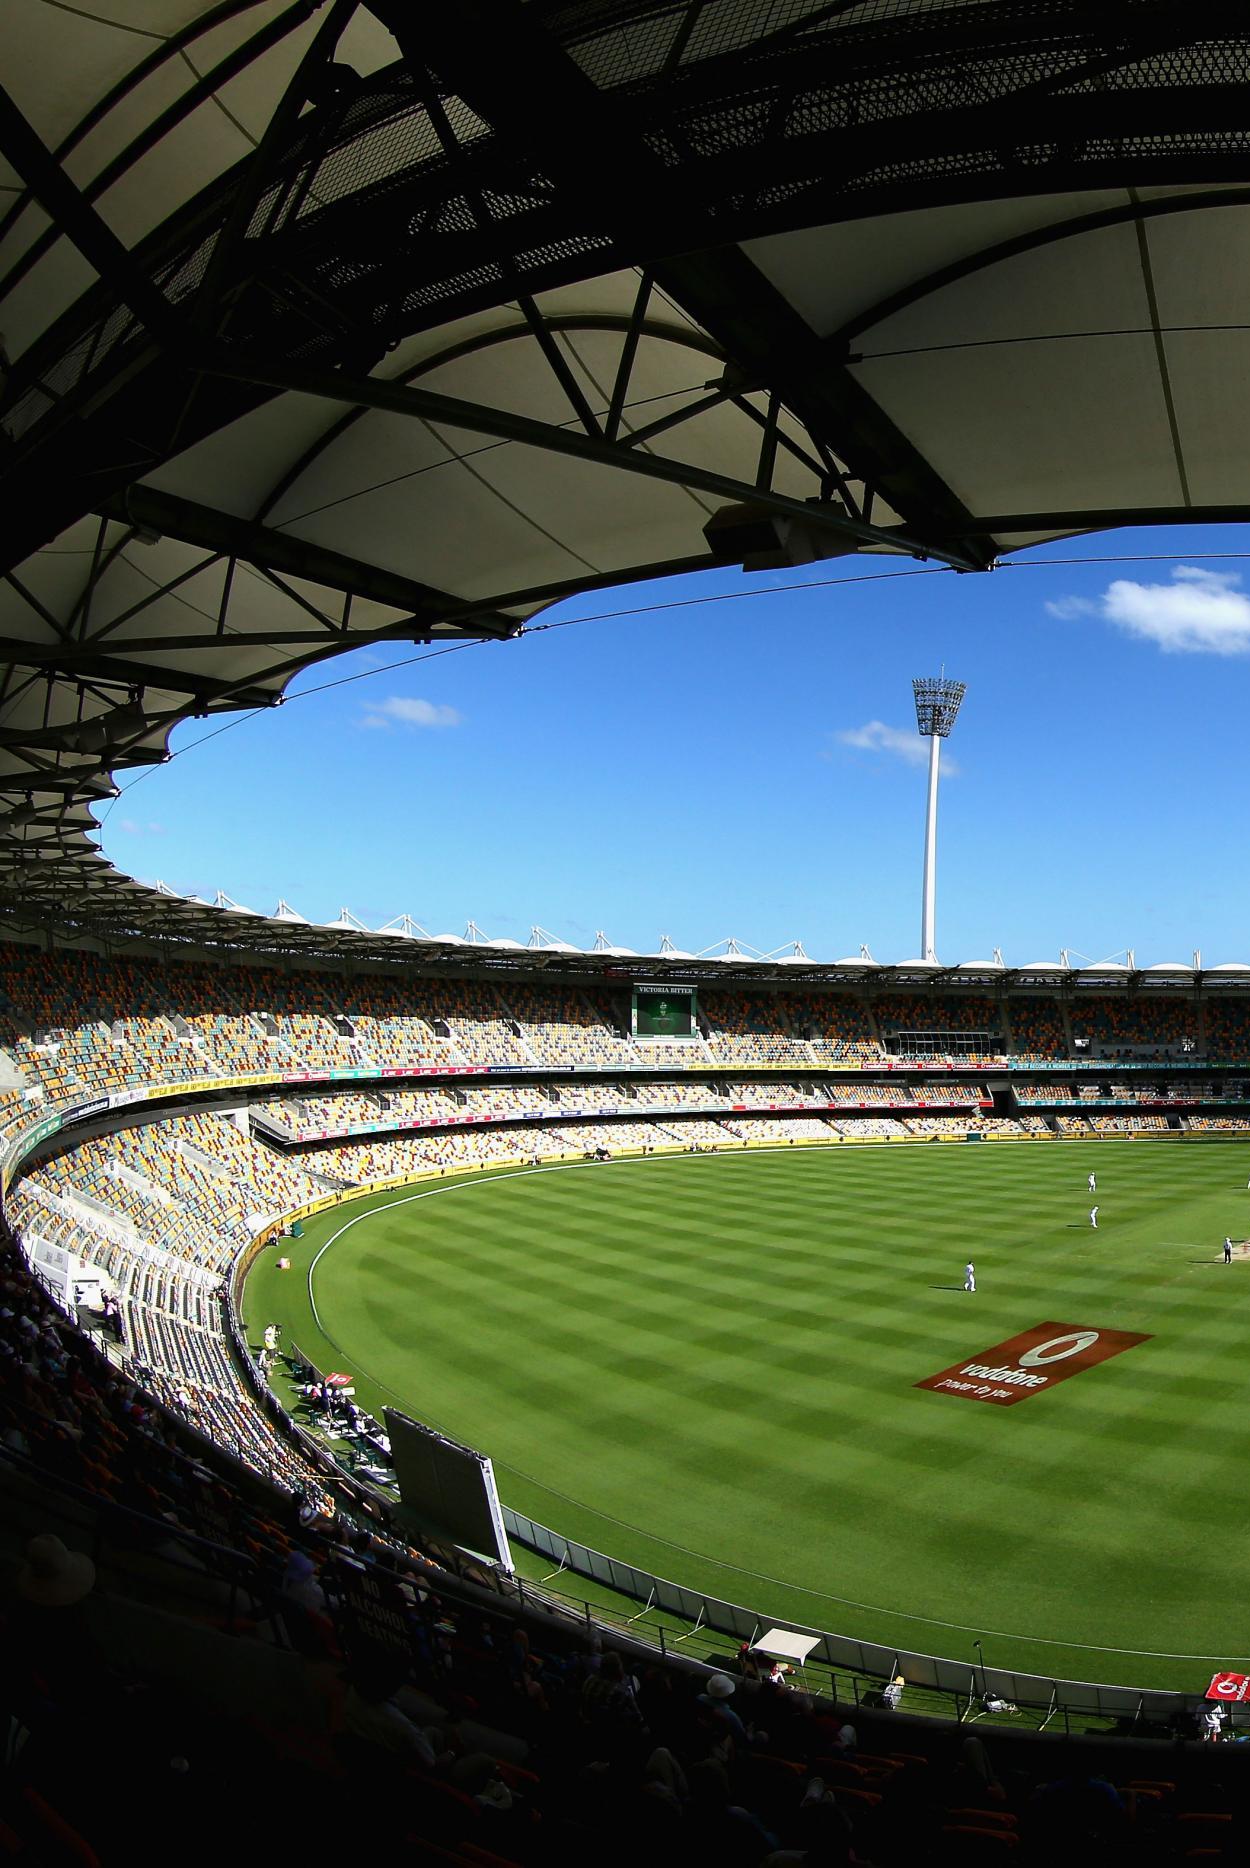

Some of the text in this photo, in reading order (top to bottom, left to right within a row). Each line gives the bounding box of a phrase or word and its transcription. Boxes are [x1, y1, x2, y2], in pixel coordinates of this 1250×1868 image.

[960, 1363, 1048, 1387] vodafone
[933, 1378, 977, 1391] power
[980, 1389, 1013, 1399] you
